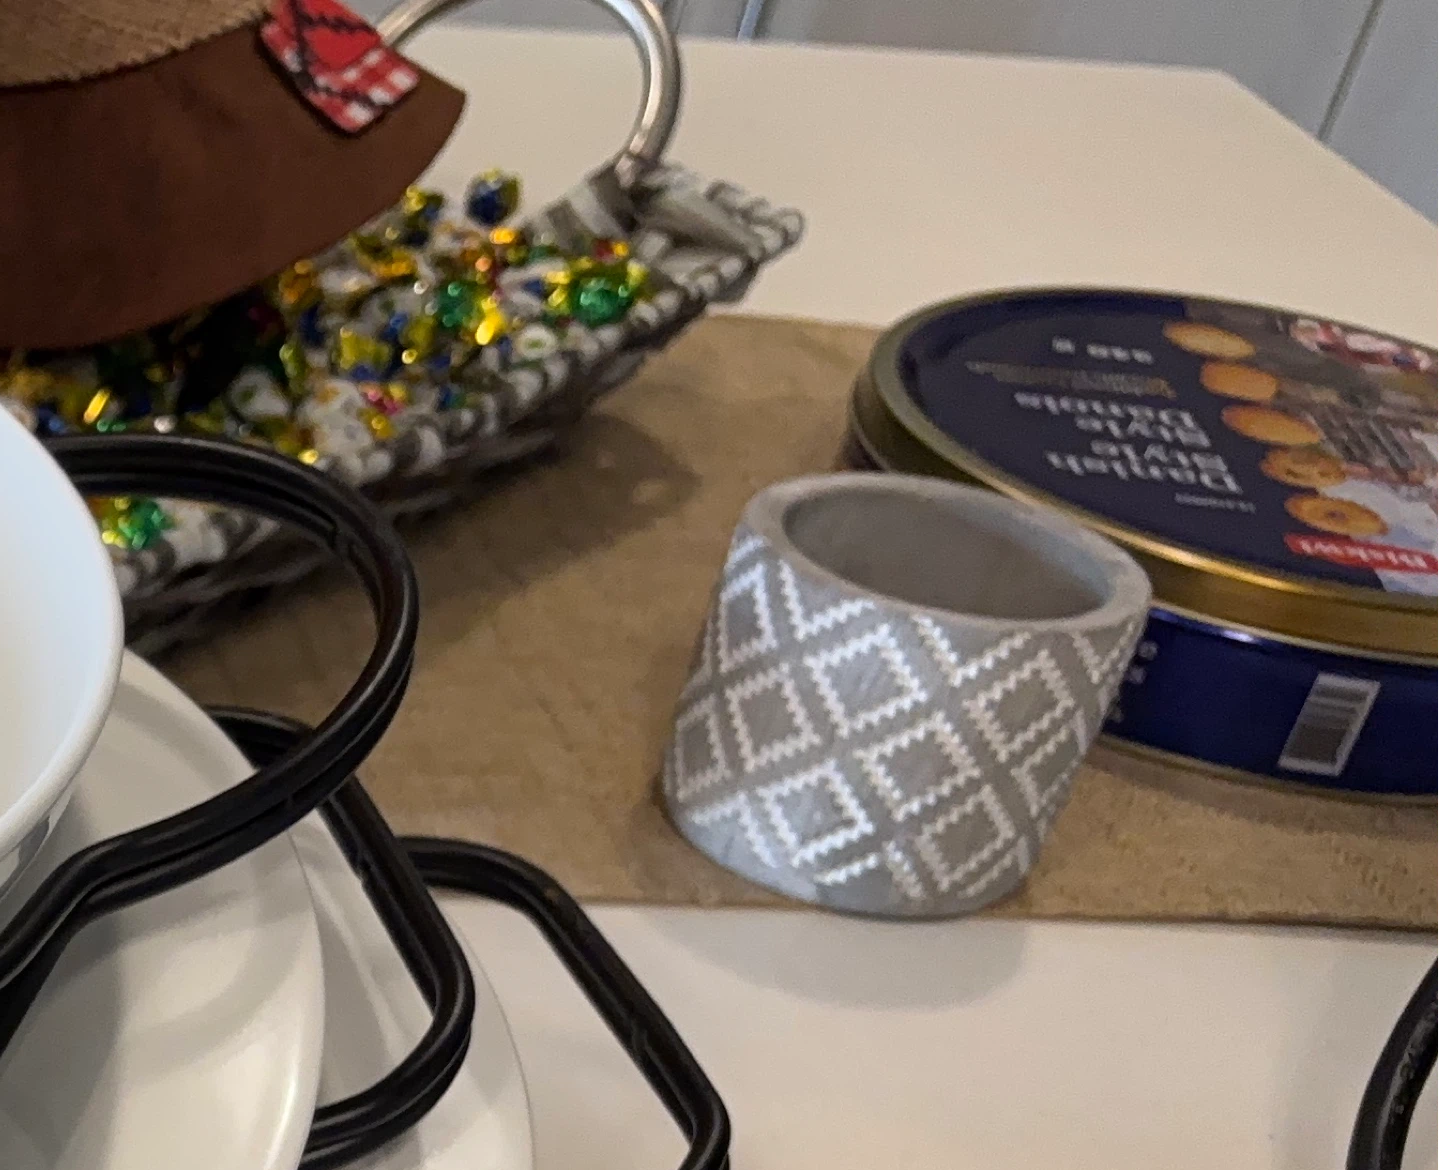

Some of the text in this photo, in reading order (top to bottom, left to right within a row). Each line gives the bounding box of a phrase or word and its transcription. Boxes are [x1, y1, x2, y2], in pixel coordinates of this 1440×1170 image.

[1074, 415, 1211, 448] Style
[1043, 450, 1243, 495] Danish
[1090, 439, 1228, 473] Style
